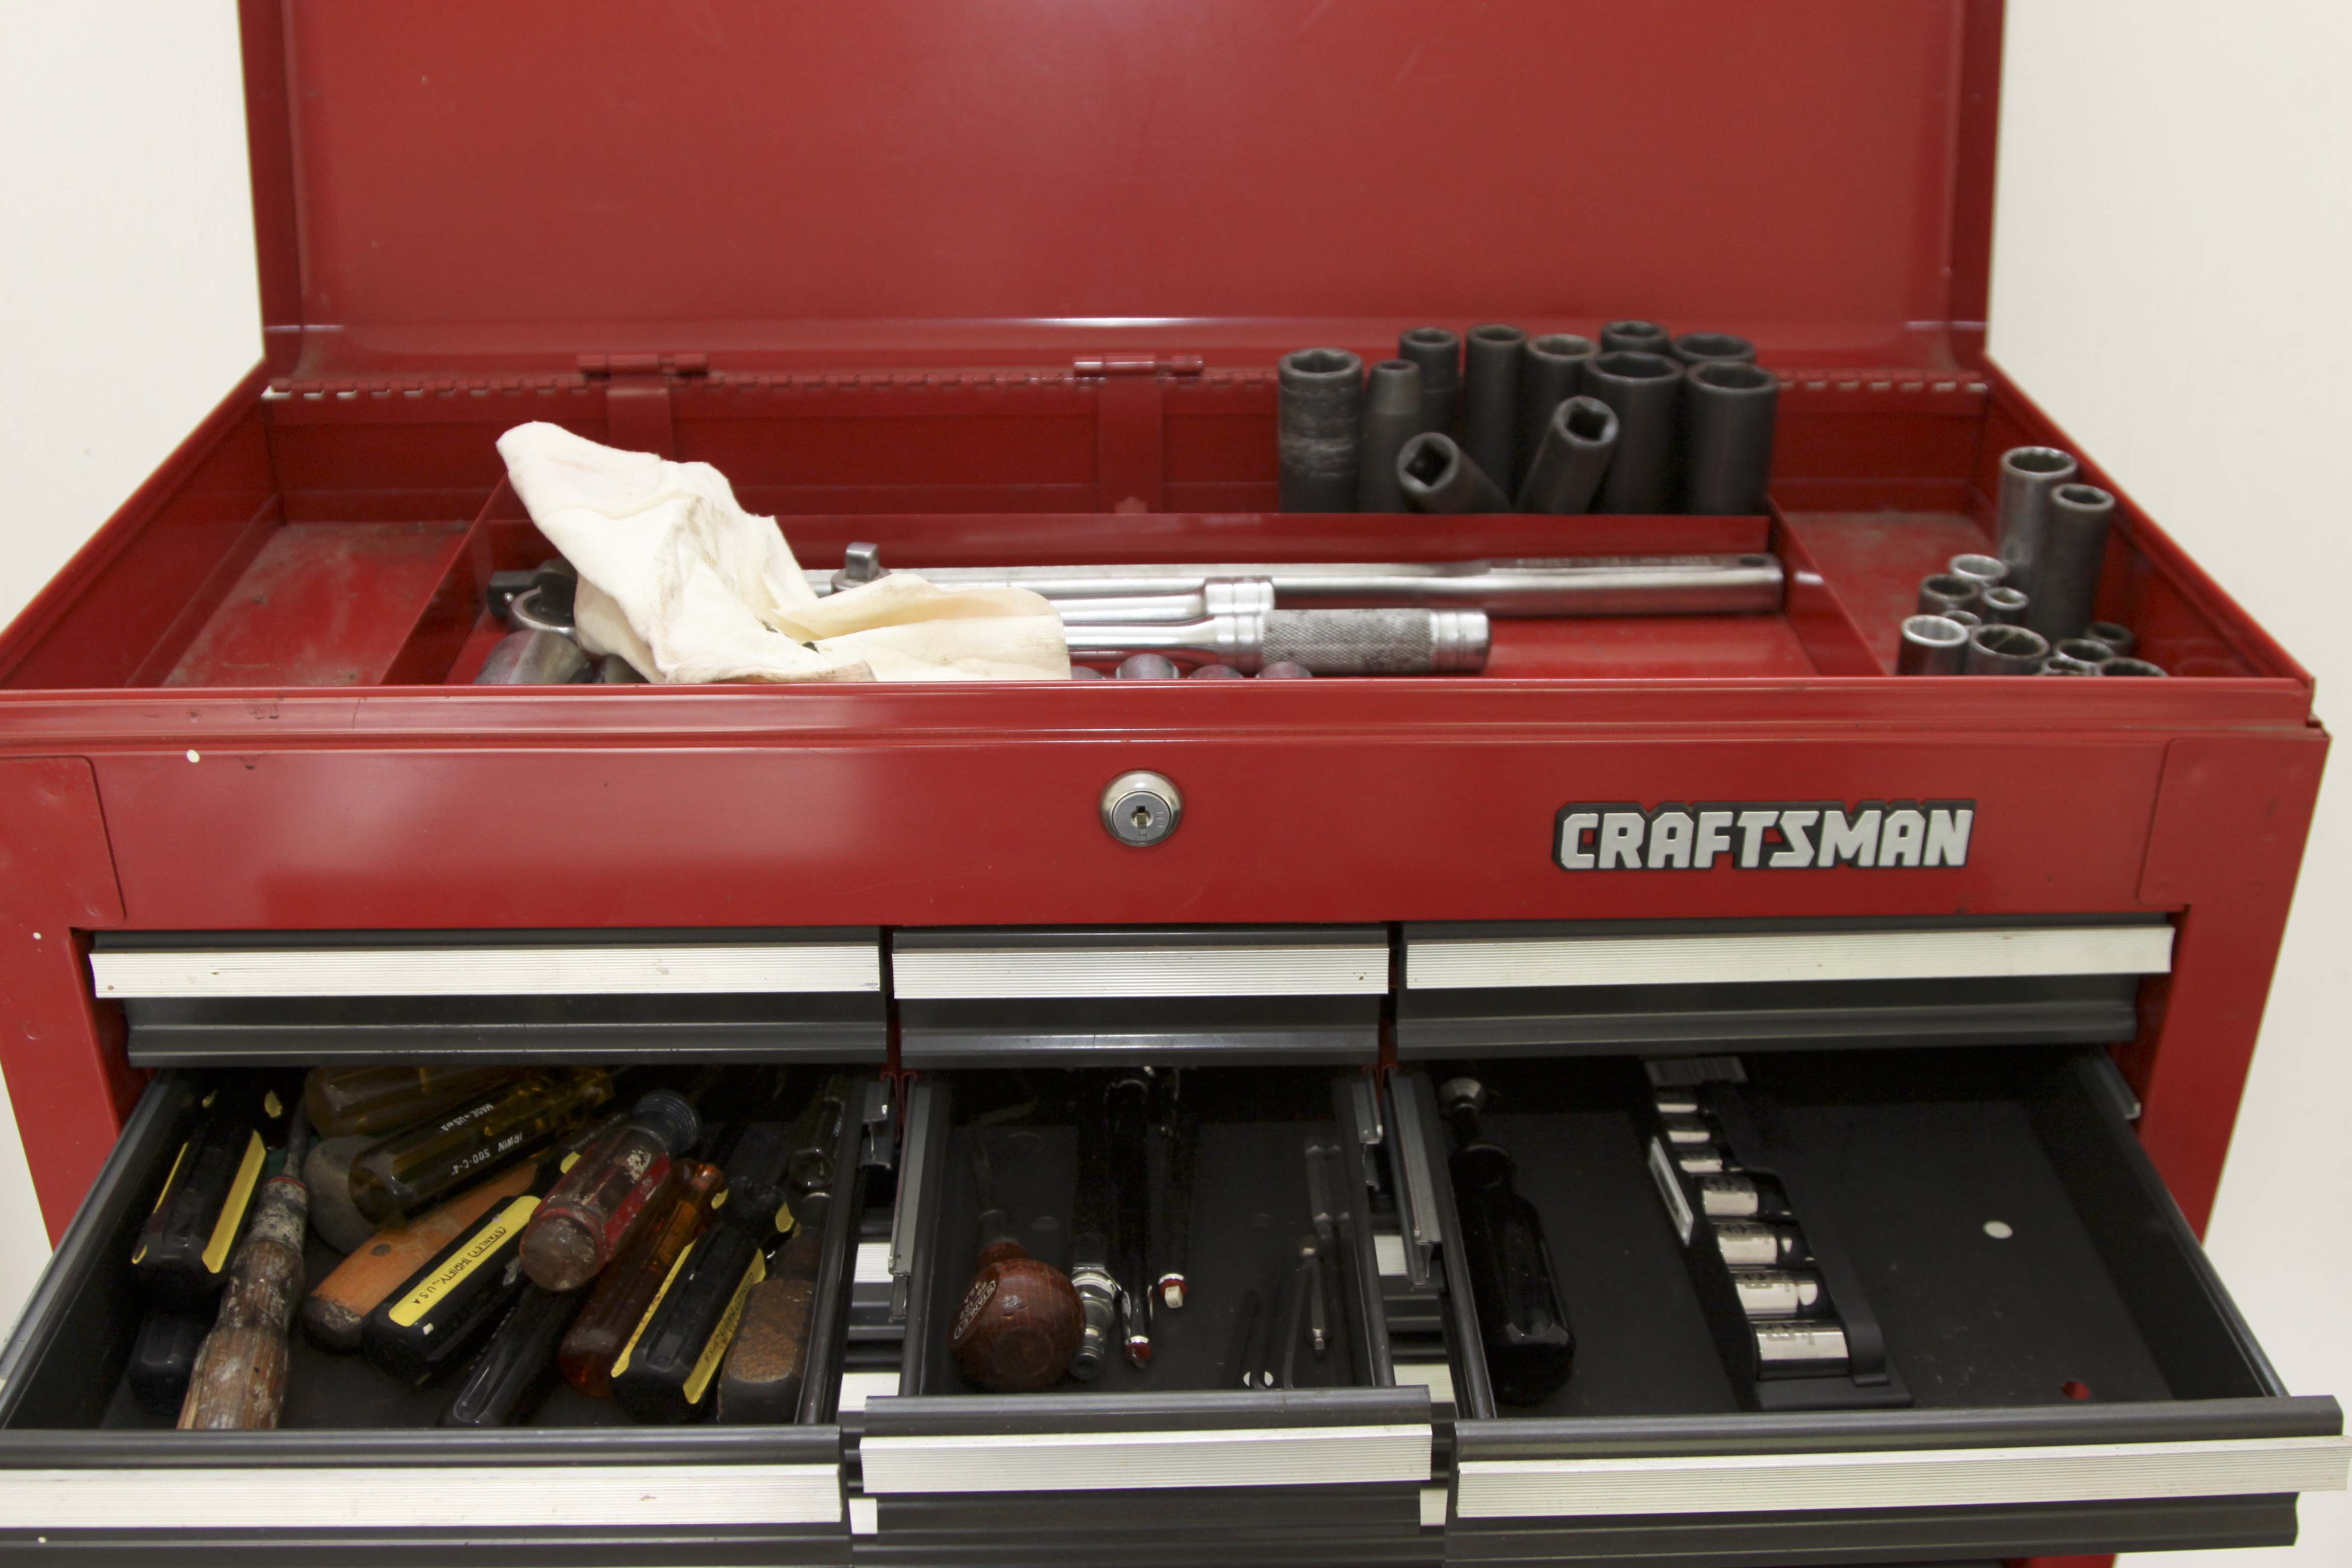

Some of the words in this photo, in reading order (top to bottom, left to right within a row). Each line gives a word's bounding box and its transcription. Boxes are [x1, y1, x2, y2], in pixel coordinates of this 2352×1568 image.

[1559, 809, 1974, 870] CRAFTSMAN
[498, 1132, 522, 1152] IRWIN
[470, 1227, 505, 1257] STANLEY
[440, 1257, 472, 1284] THRIFTY
